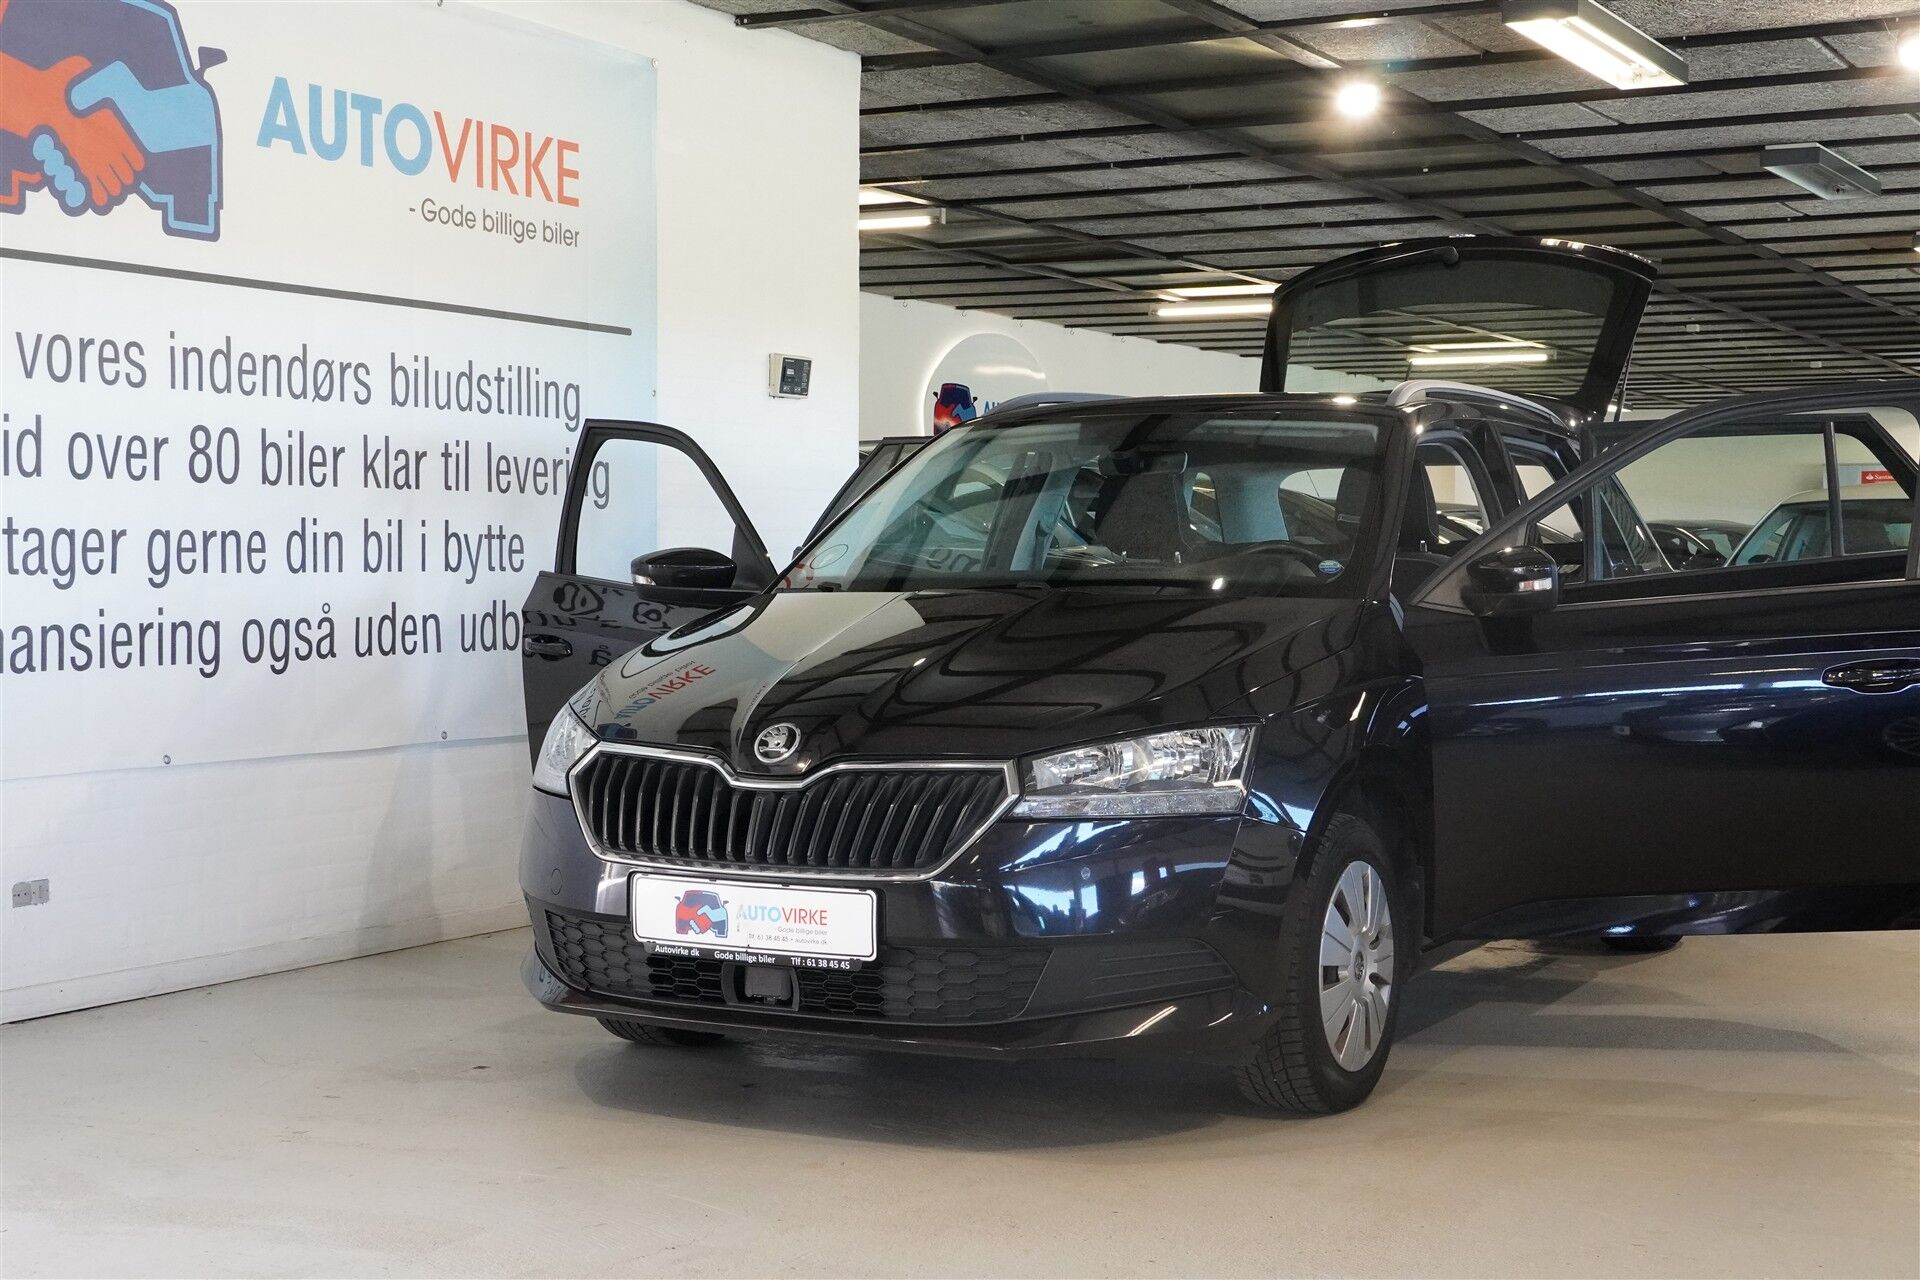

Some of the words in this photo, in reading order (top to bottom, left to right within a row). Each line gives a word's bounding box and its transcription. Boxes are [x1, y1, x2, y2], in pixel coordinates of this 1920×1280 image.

[257, 76, 580, 208] AUTOVIRKE
[421, 198, 476, 229] Gode
[482, 208, 537, 244] billige
[543, 220, 580, 247] biler
[16, 331, 146, 390] vores
[170, 331, 372, 407] indendørs
[390, 352, 581, 433] biludstilling
[67, 431, 169, 482] over
[189, 424, 240, 487] 80
[261, 427, 345, 489] biler
[363, 434, 427, 491] klar
[441, 441, 470, 493] til
[487, 441, 609, 510] leverig
[2, 517, 127, 590] tager
[147, 529, 267, 589] gerne
[286, 517, 344, 575] din
[363, 518, 403, 575] bil
[421, 519, 428, 573] i
[444, 519, 525, 585] bytte
[0, 607, 221, 679] ansiering
[242, 602, 337, 675] også
[355, 601, 442, 657] uden
[736, 904, 828, 926] AUTOVIRKE
[714, 951, 733, 959] Gode
[735, 953, 757, 963] billige
[758, 955, 775, 964] biler
[807, 958, 816, 966] 61
[818, 959, 827, 967] 38
[829, 960, 839, 968] 45
[840, 961, 850, 969] 45
